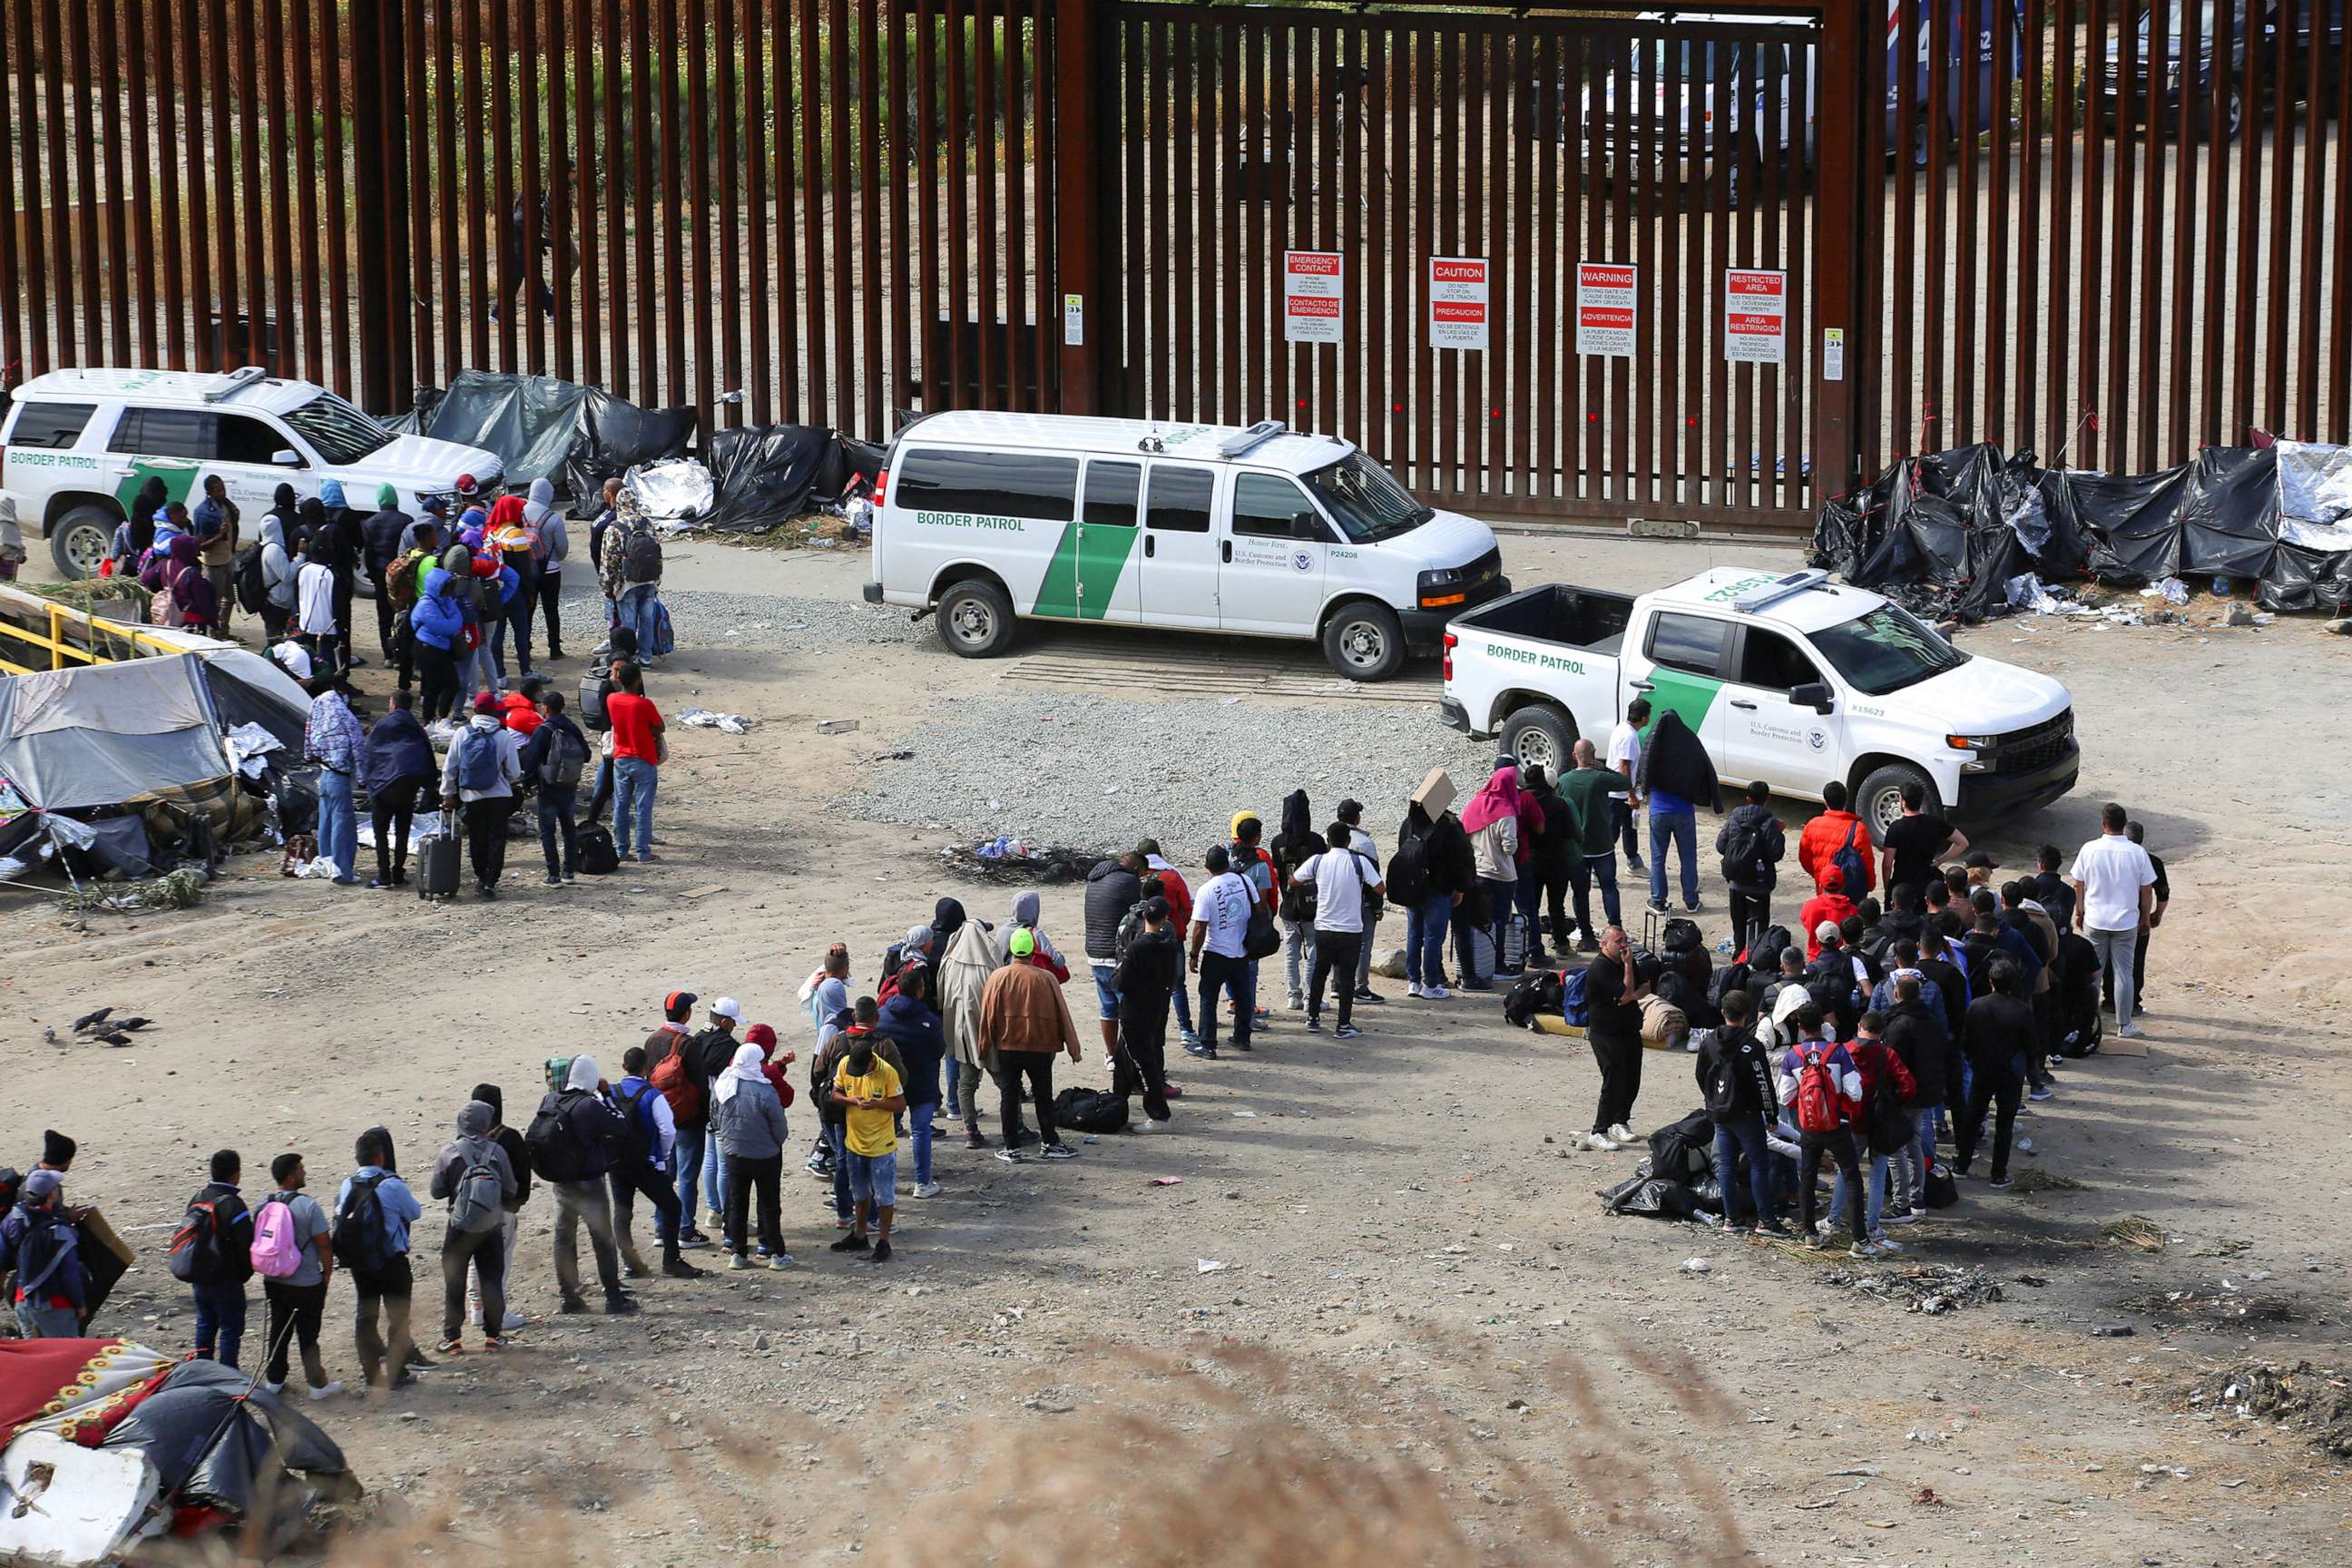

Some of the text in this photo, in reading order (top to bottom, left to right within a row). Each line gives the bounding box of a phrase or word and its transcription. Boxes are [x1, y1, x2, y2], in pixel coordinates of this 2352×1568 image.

[1289, 256, 1338, 265] EMERGENCY
[1295, 264, 1332, 272] CONTACT
[1436, 267, 1482, 278] CAUTION
[1583, 272, 1632, 283] WARNING
[1730, 275, 1780, 284] RESTRICTED
[1289, 299, 1328, 307] CONTACTO
[1291, 306, 1338, 315] EMERGENCIA
[1436, 308, 1483, 317] PRECAUCION
[1583, 313, 1632, 322] ADVERTENCIA
[1730, 323, 1780, 332] RESTRINGIDA
[11, 452, 98, 469] BORDER PATROL
[916, 512, 1025, 532] BORDER PATROL
[1249, 538, 1270, 546] Honor
[1249, 551, 1274, 559] Customs
[1330, 550, 1358, 559] P24208
[1257, 559, 1288, 567] Protection
[1487, 644, 1586, 675] BORDER PATROL
[1852, 704, 1886, 717] K15623
[1763, 724, 1788, 734] Customs
[1750, 729, 1802, 743] Border Protection
